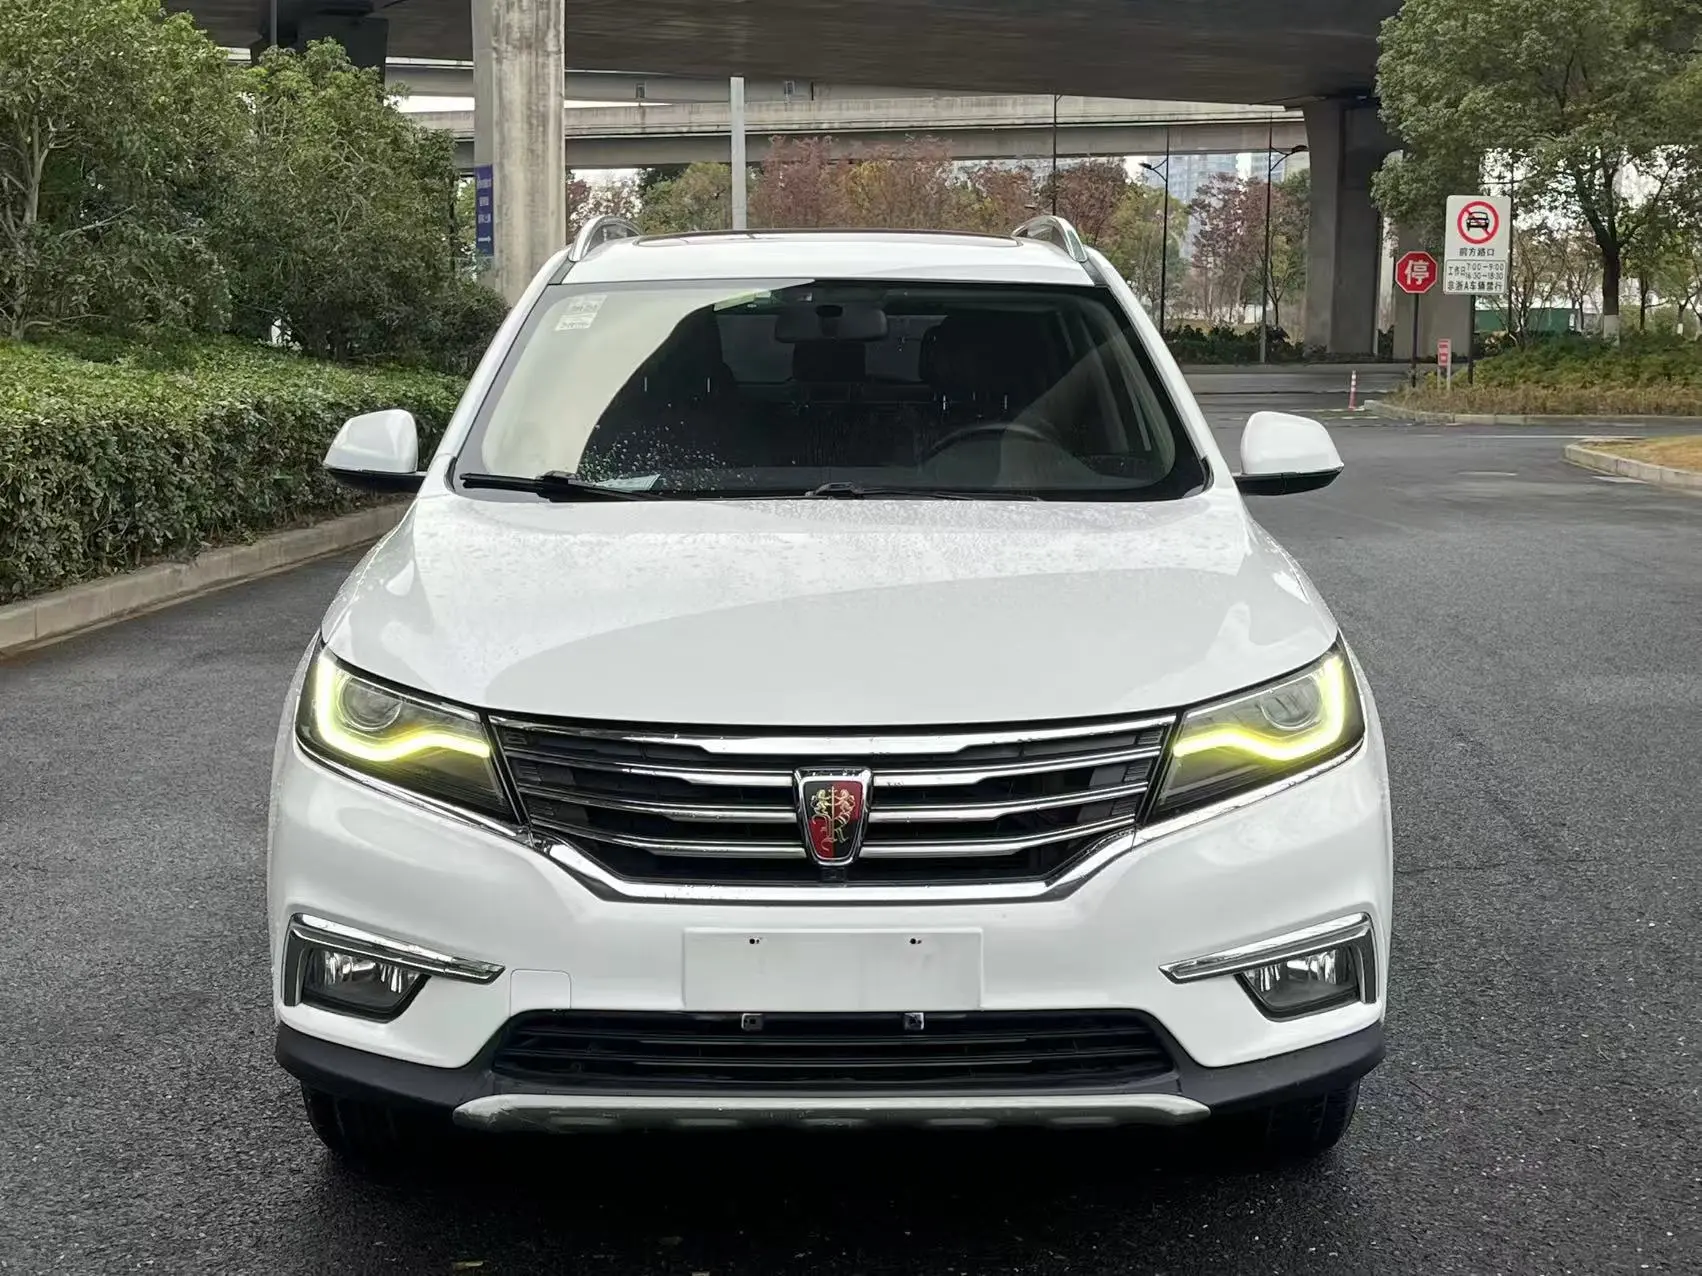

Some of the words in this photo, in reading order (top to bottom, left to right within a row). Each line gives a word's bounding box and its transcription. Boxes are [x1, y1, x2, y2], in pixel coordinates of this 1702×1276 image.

[1459, 247, 1495, 257] 前方路口
[1405, 260, 1429, 285] 停
